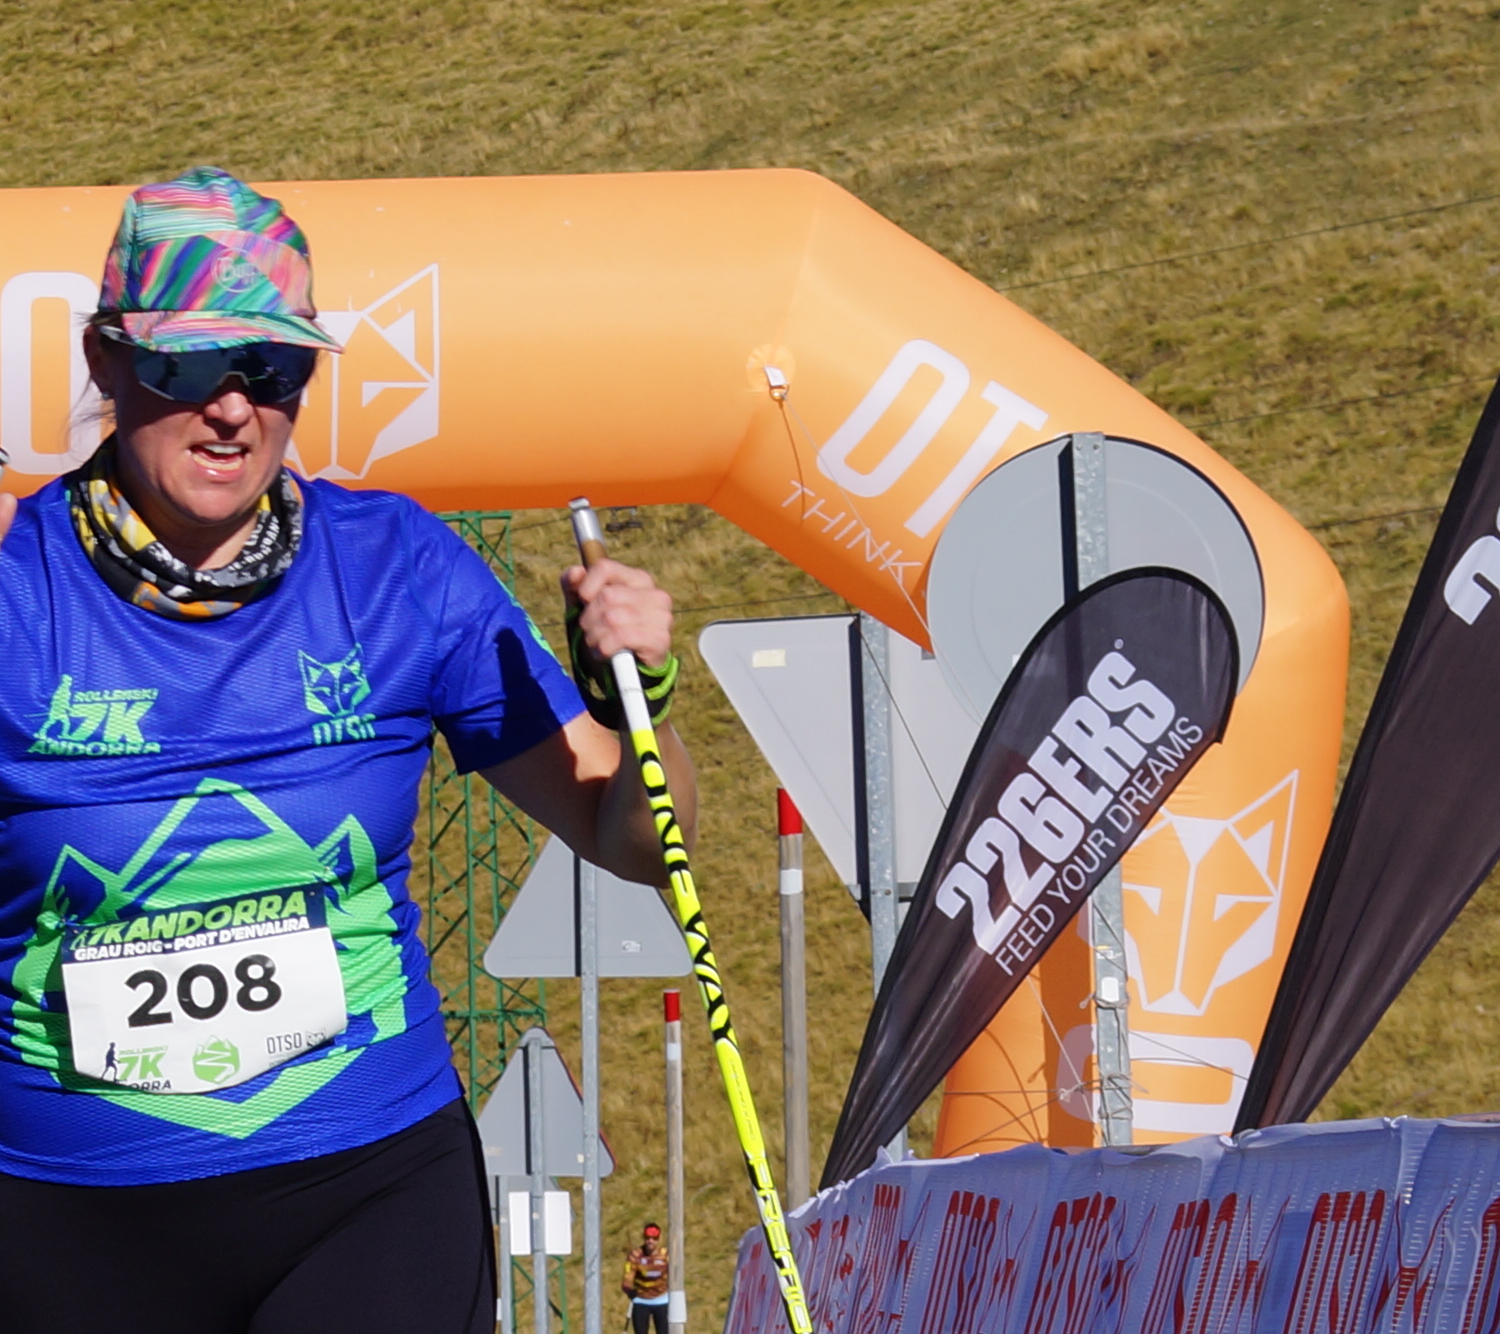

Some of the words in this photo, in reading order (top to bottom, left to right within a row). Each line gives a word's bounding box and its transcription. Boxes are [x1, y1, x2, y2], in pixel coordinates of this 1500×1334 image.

[817, 339, 1049, 539] OT
[781, 480, 923, 587] THINK
[27, 739, 162, 756] ANDORRA
[69, 700, 155, 743] 7K
[935, 651, 1177, 956] 226ERS
[994, 902, 1057, 977] FEED
[1047, 831, 1117, 911] YOUR
[1108, 714, 1206, 832] DREAMS
[74, 943, 124, 961] GRAU
[122, 940, 164, 957] ROIG
[173, 931, 218, 951] PORT
[218, 916, 310, 944] D'ENVALIRA
[640, 750, 690, 893] ONE
[685, 910, 740, 1051] WAY
[123, 953, 283, 1029] 208
[118, 1052, 169, 1081] 7K
[266, 1031, 303, 1055] OTSO
[129, 1078, 172, 1092] ORRA
[748, 1155, 814, 1334] PREMIO
